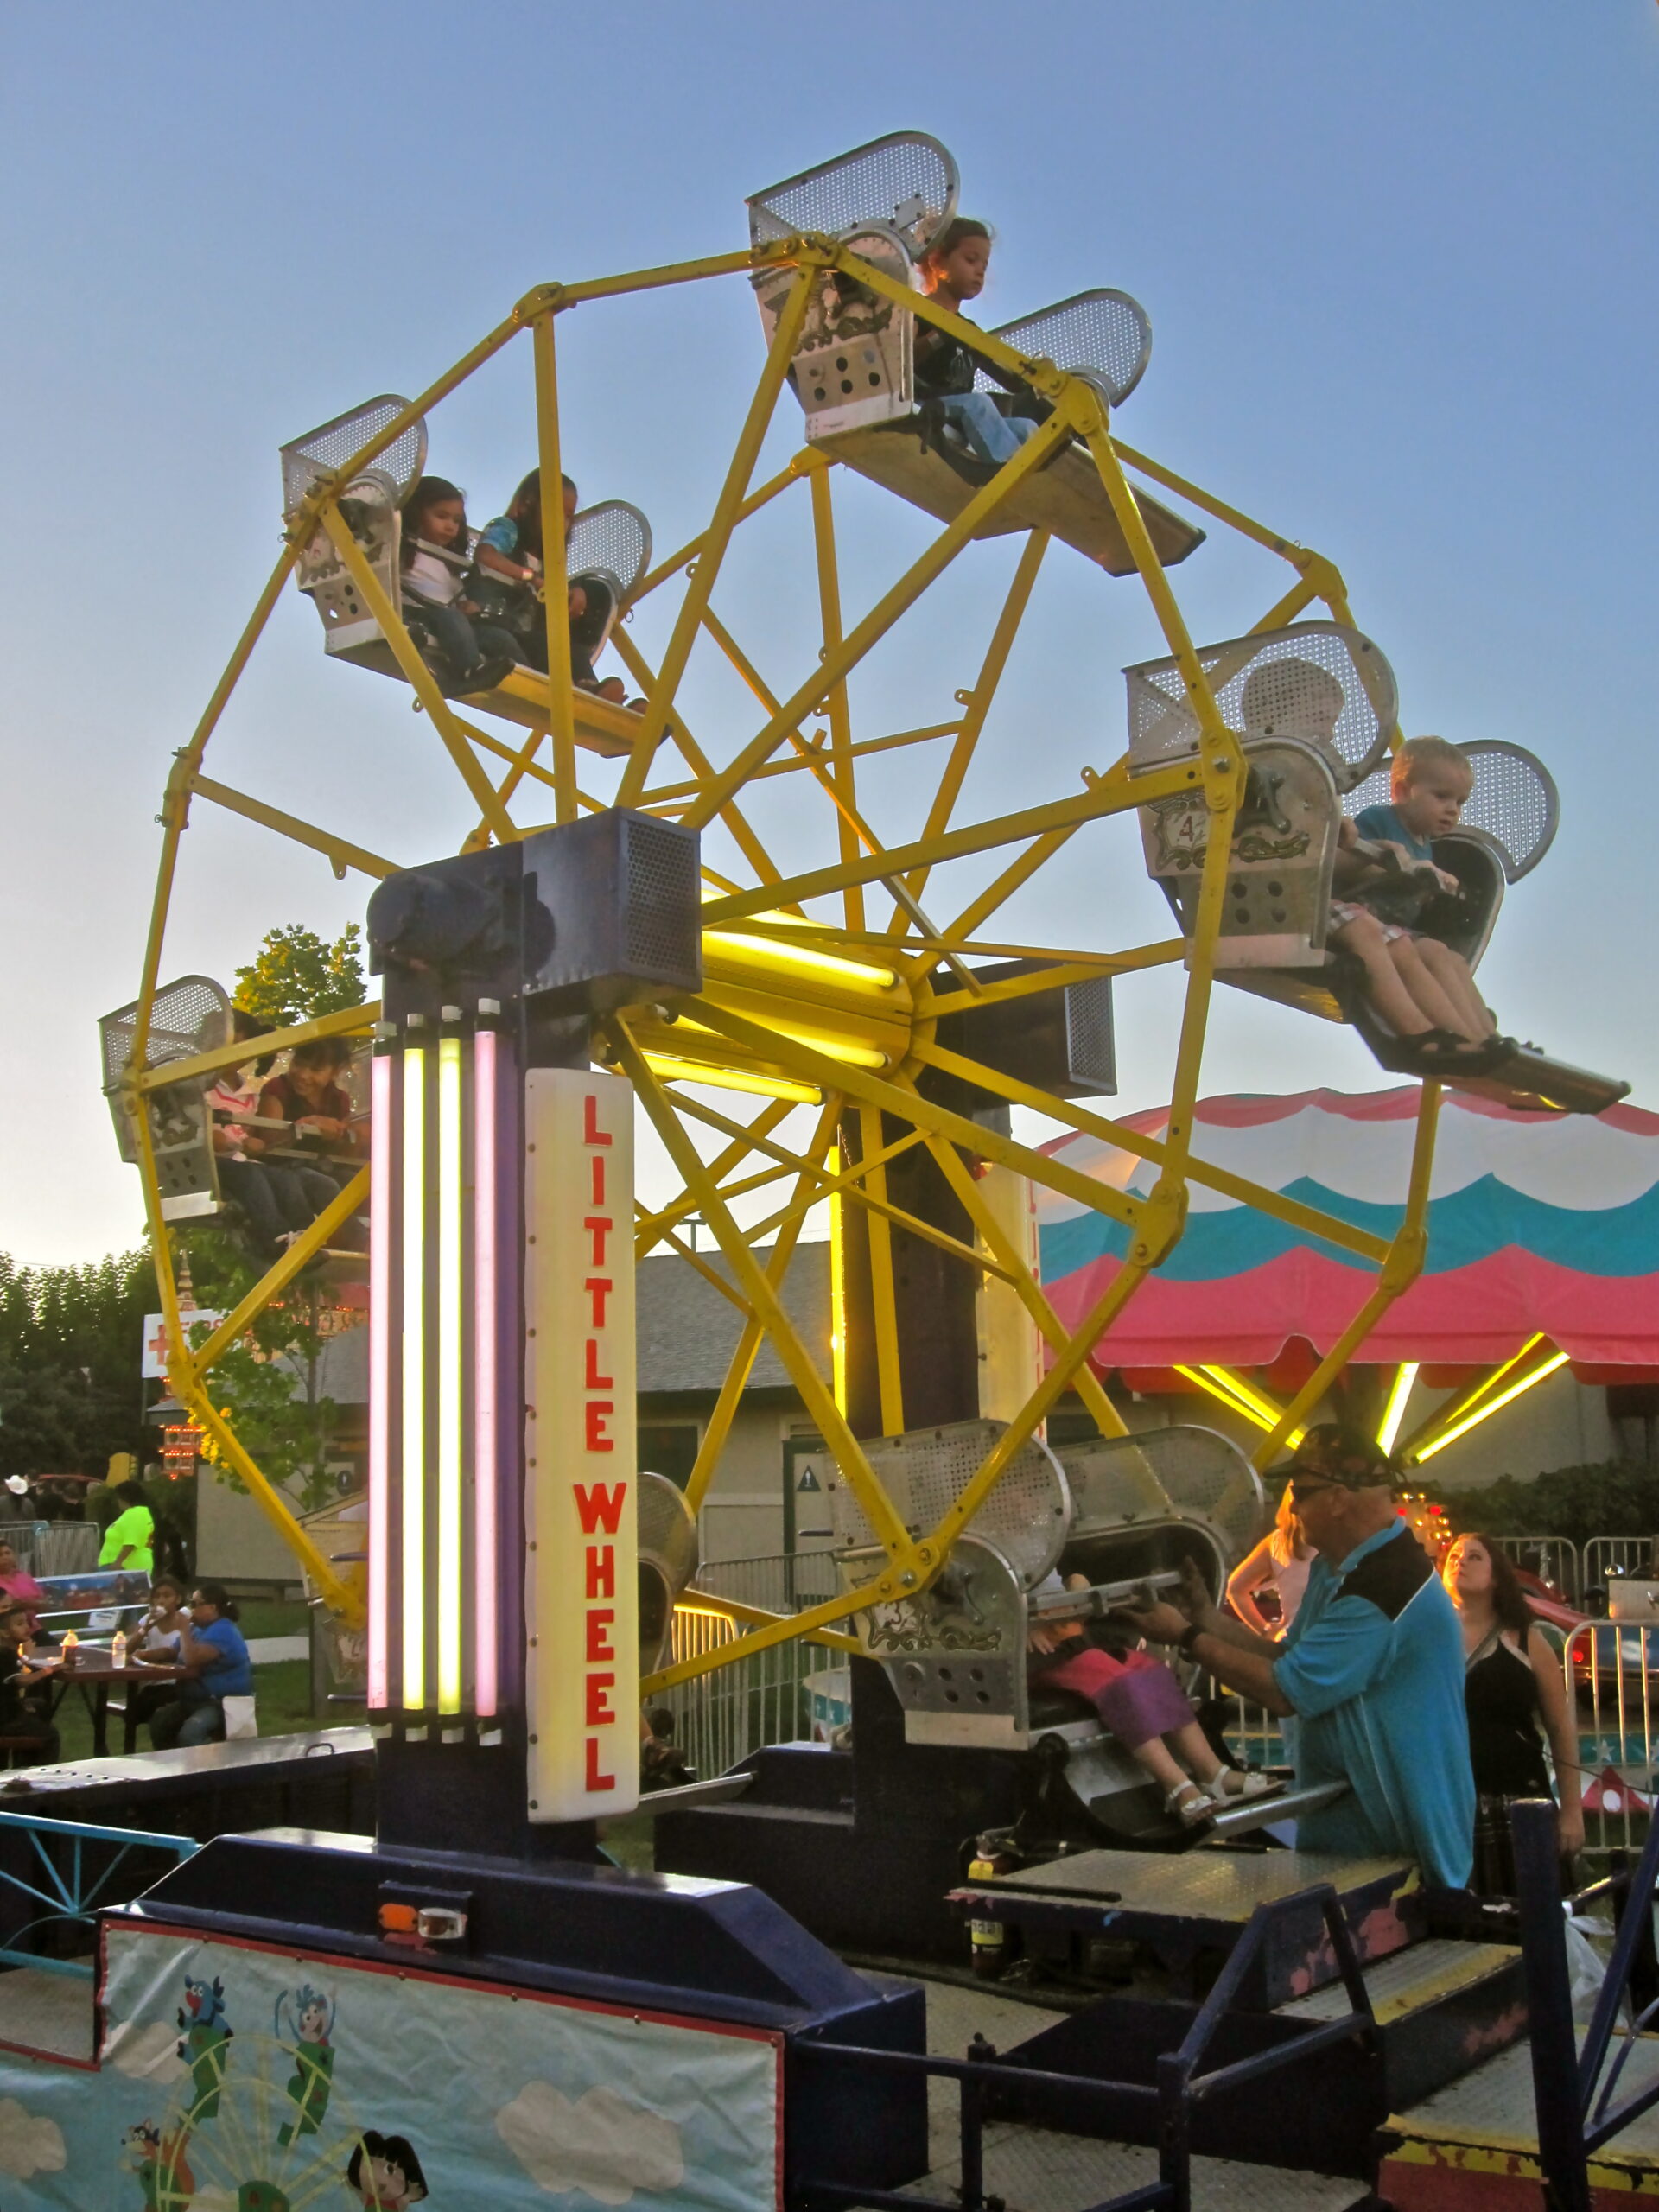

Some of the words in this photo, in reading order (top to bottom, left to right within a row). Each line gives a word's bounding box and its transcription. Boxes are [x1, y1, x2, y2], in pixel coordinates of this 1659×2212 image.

[1179, 815, 1194, 842] 4
[583, 1095, 615, 1452] LITTLE
[573, 1481, 627, 1793] WHEEL
